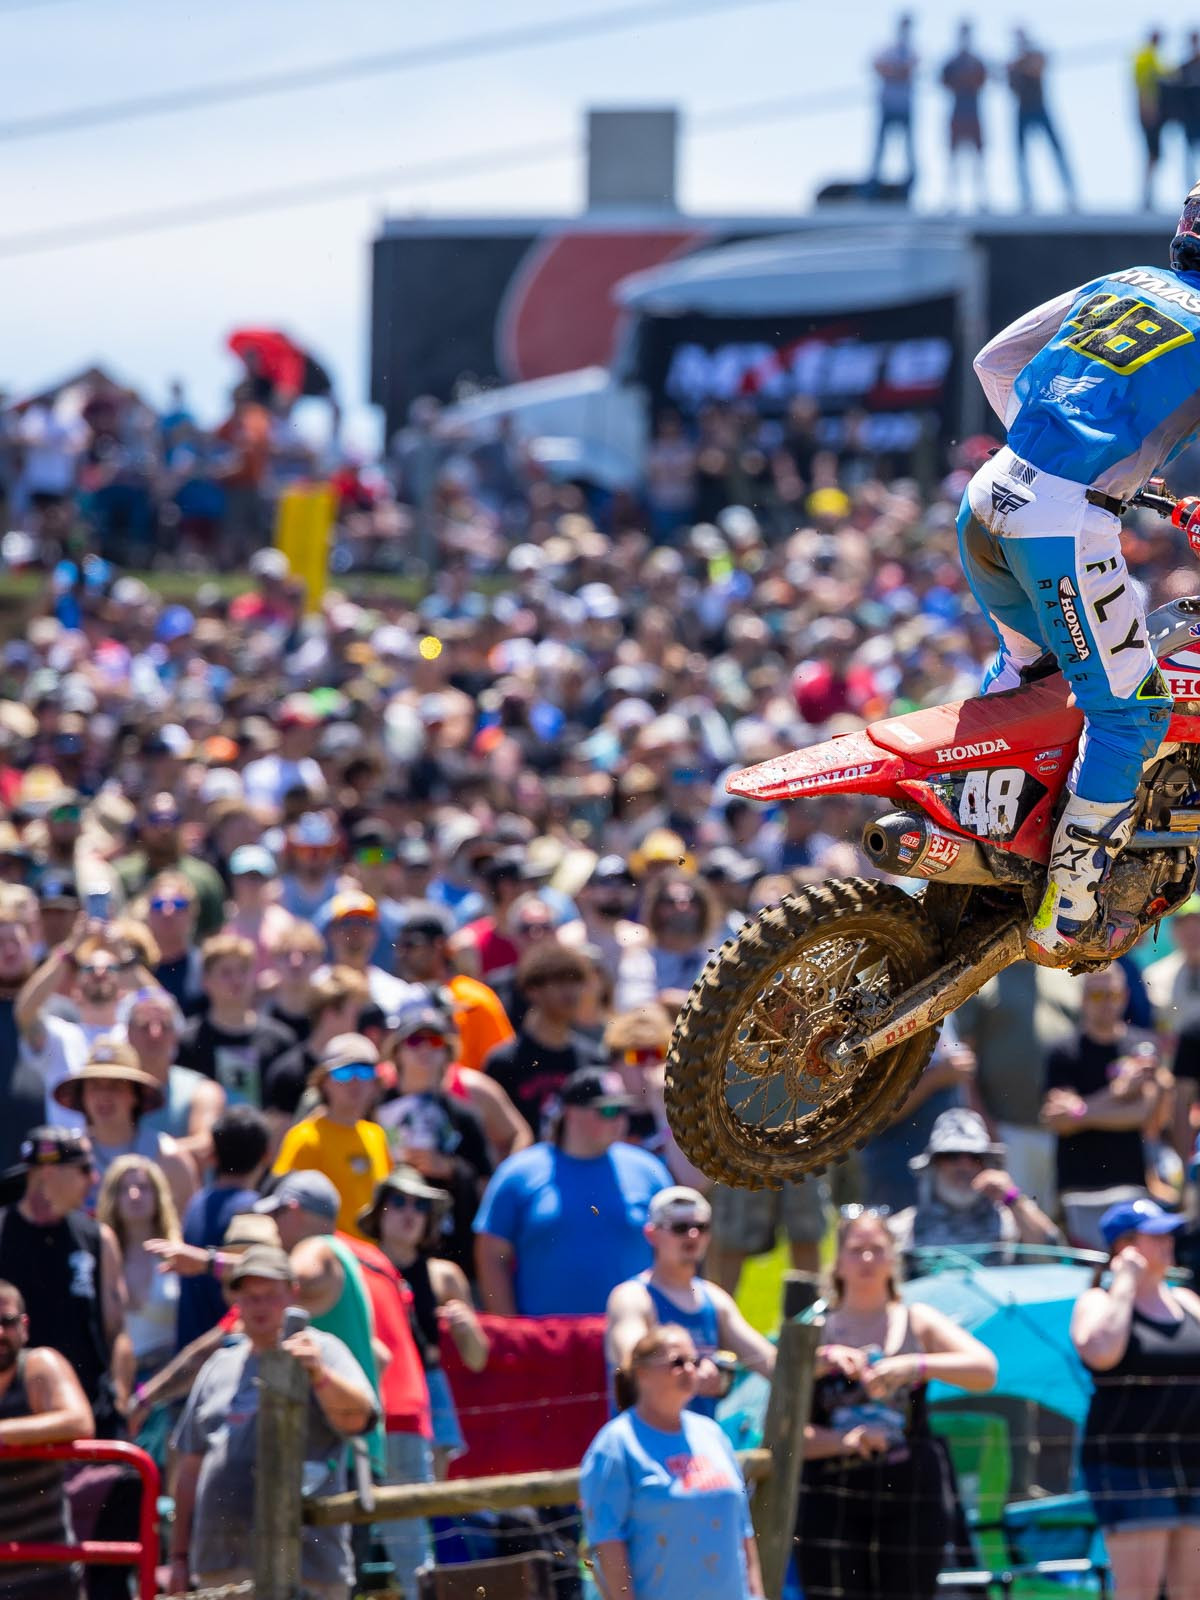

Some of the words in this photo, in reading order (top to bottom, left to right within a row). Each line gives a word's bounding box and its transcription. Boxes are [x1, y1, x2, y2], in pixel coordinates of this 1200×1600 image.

[1059, 292, 1196, 376] 48
[1039, 387, 1082, 416] HONDA
[1037, 578, 1088, 682] RACING
[1060, 597, 1091, 661] HONDA
[1085, 556, 1145, 655] FLY
[787, 764, 873, 792] DUNLOP
[935, 738, 1011, 763] HONDA
[958, 768, 1026, 836] 48
[884, 1018, 917, 1045] DID
